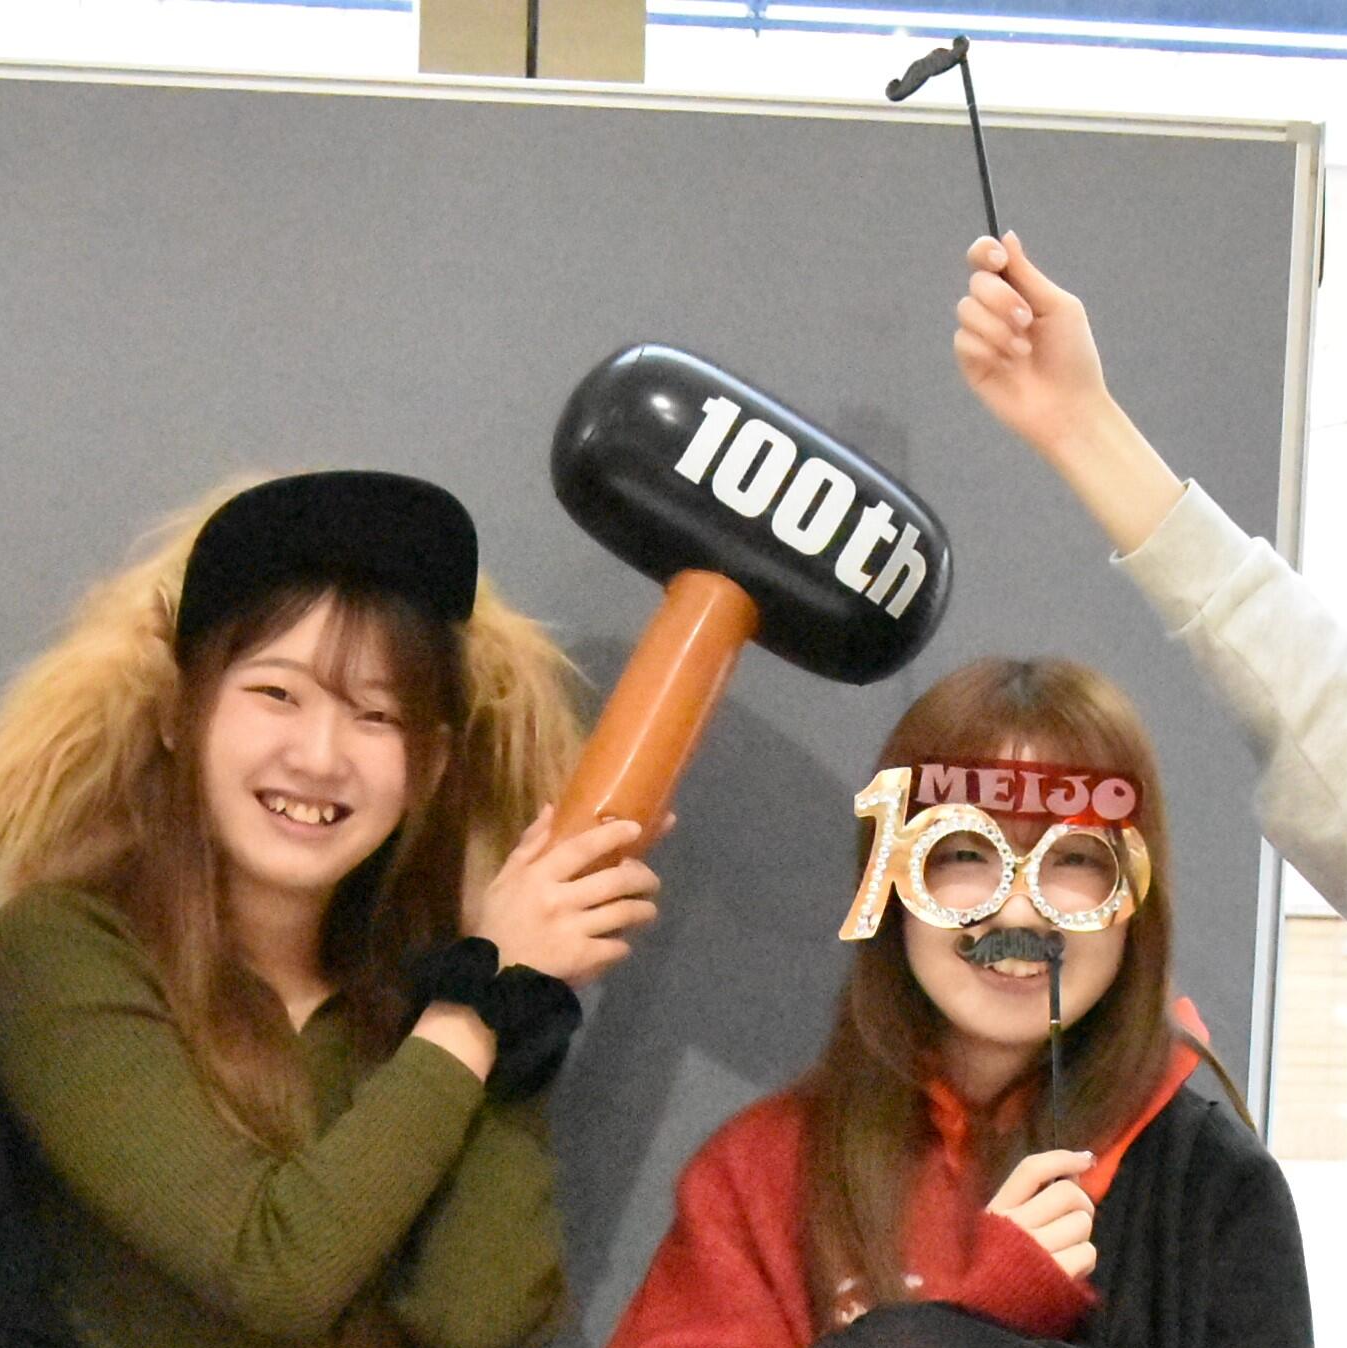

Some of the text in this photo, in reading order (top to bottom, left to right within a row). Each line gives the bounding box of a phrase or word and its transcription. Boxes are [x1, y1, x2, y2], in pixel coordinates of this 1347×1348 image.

[674, 396, 927, 620] 100th
[838, 767, 1152, 941] 100
[915, 763, 1137, 821] MEIJO
